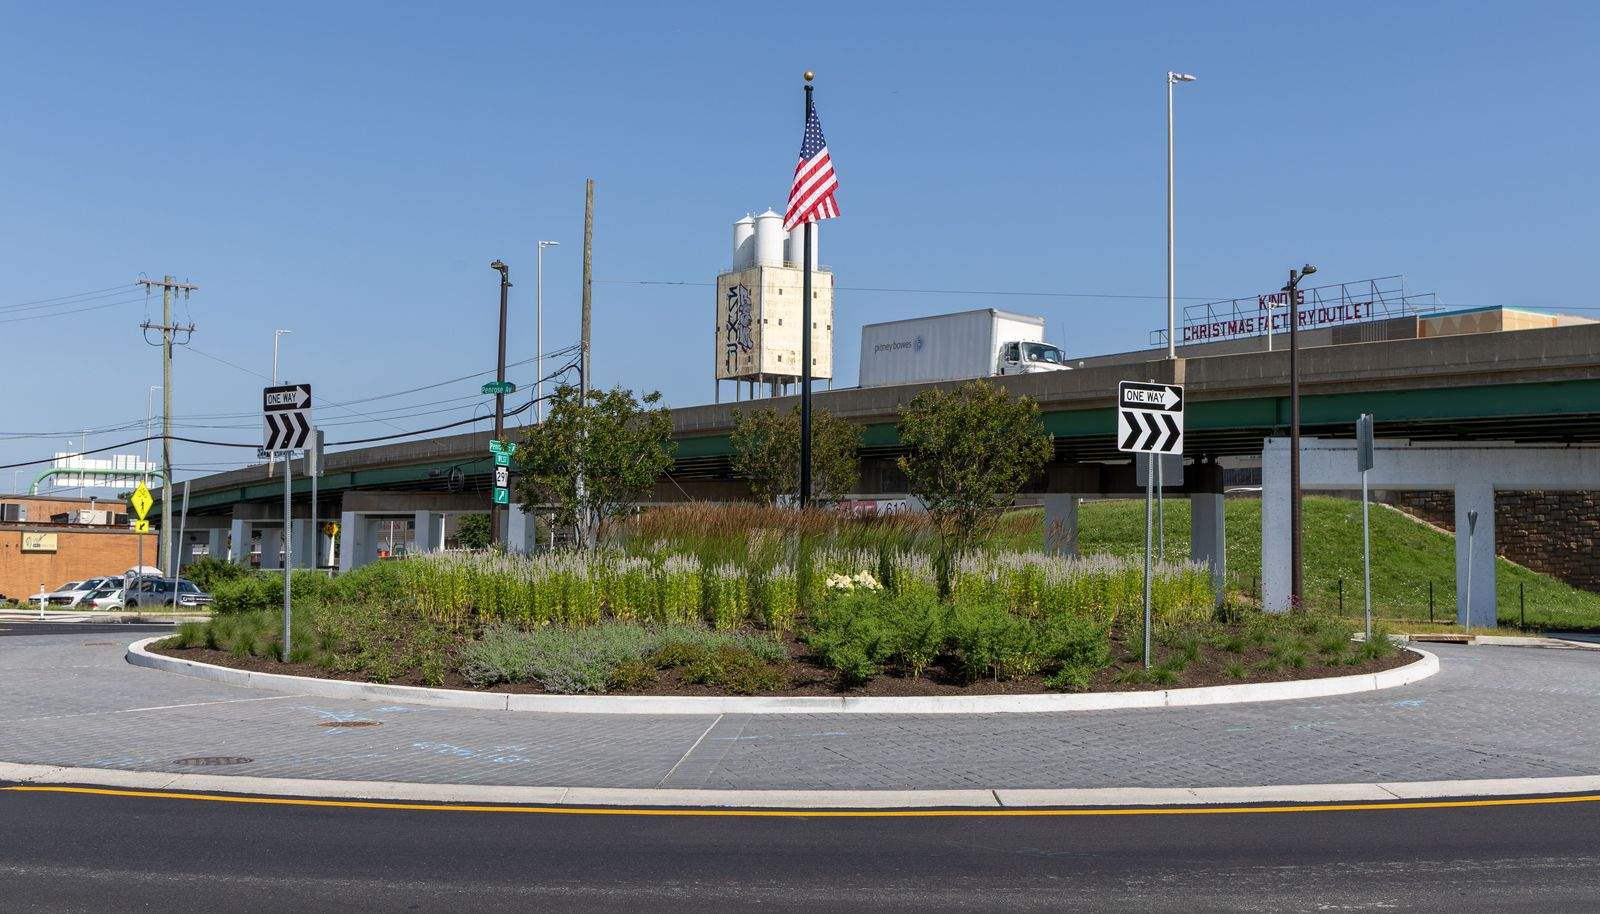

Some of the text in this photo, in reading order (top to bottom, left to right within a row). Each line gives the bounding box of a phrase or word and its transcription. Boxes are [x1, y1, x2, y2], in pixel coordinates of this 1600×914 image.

[1183, 301, 1373, 340] CHRISTMAS FACTRY OUTLET
[267, 392, 297, 405] ONE WAY
[1126, 390, 1165, 403] ONE WAY
